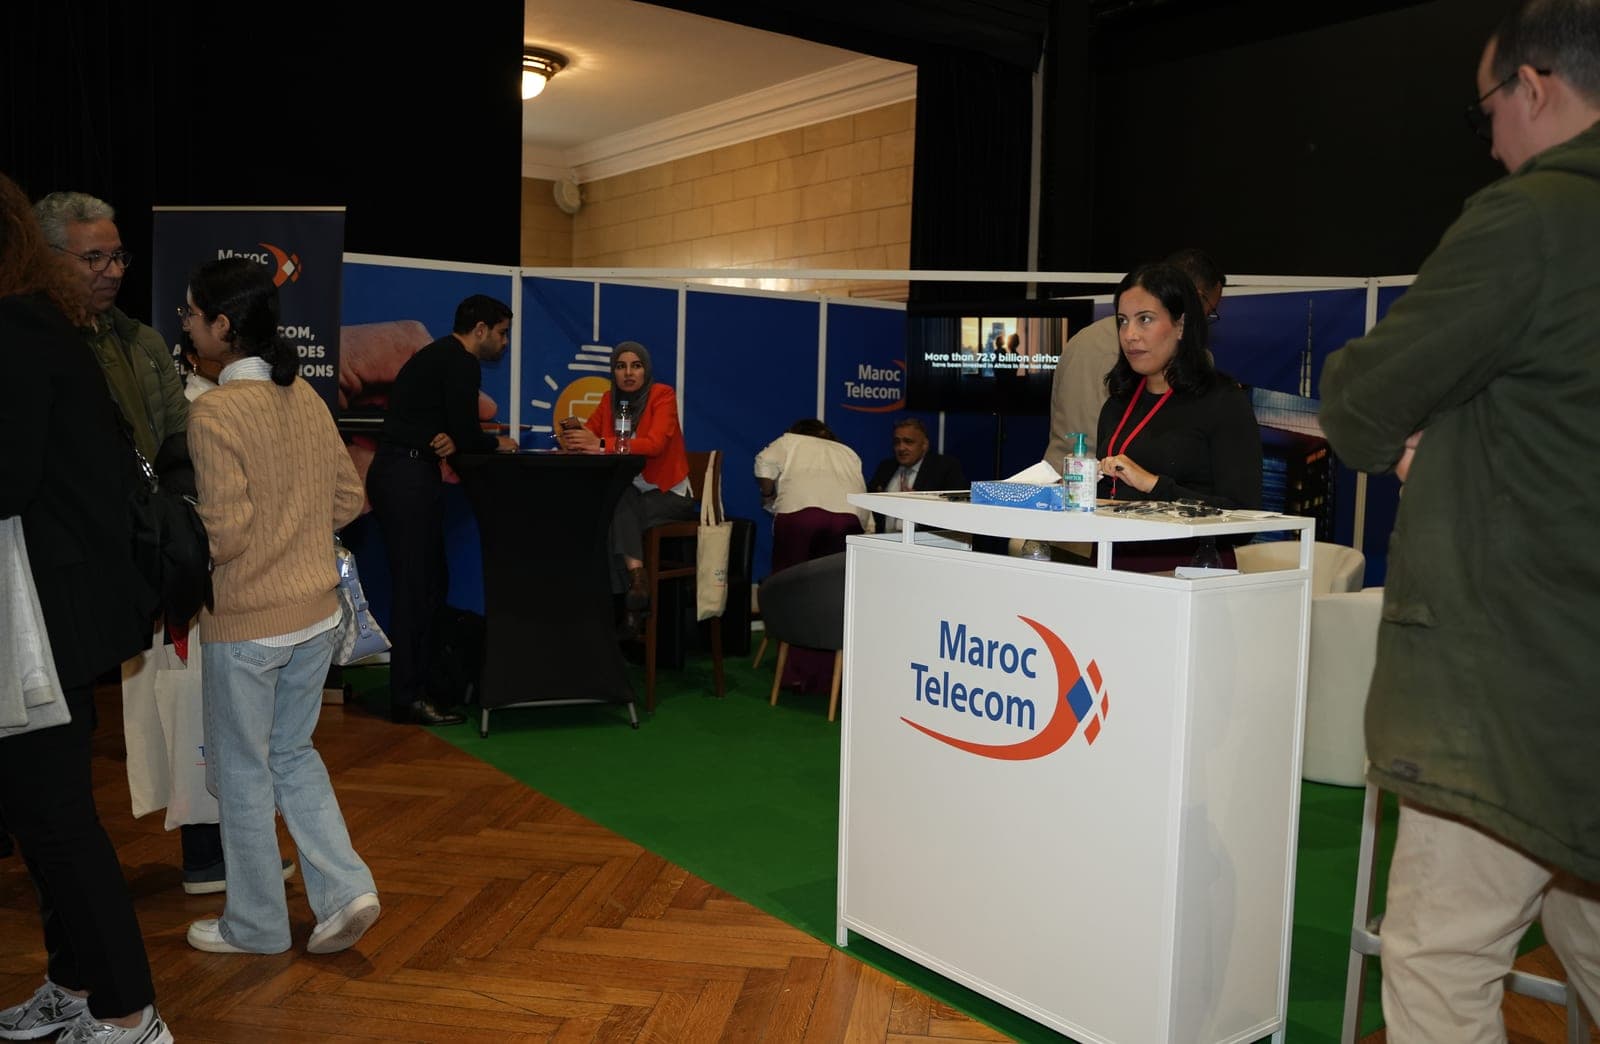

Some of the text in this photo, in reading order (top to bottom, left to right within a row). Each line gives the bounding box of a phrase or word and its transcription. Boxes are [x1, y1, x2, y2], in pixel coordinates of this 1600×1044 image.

[924, 352, 1061, 363] More than 72.9 billion dirha
[858, 364, 901, 382] Maroc
[844, 382, 901, 400] Telecom
[939, 620, 1037, 679] Maroc
[910, 662, 1036, 731] Telecom
